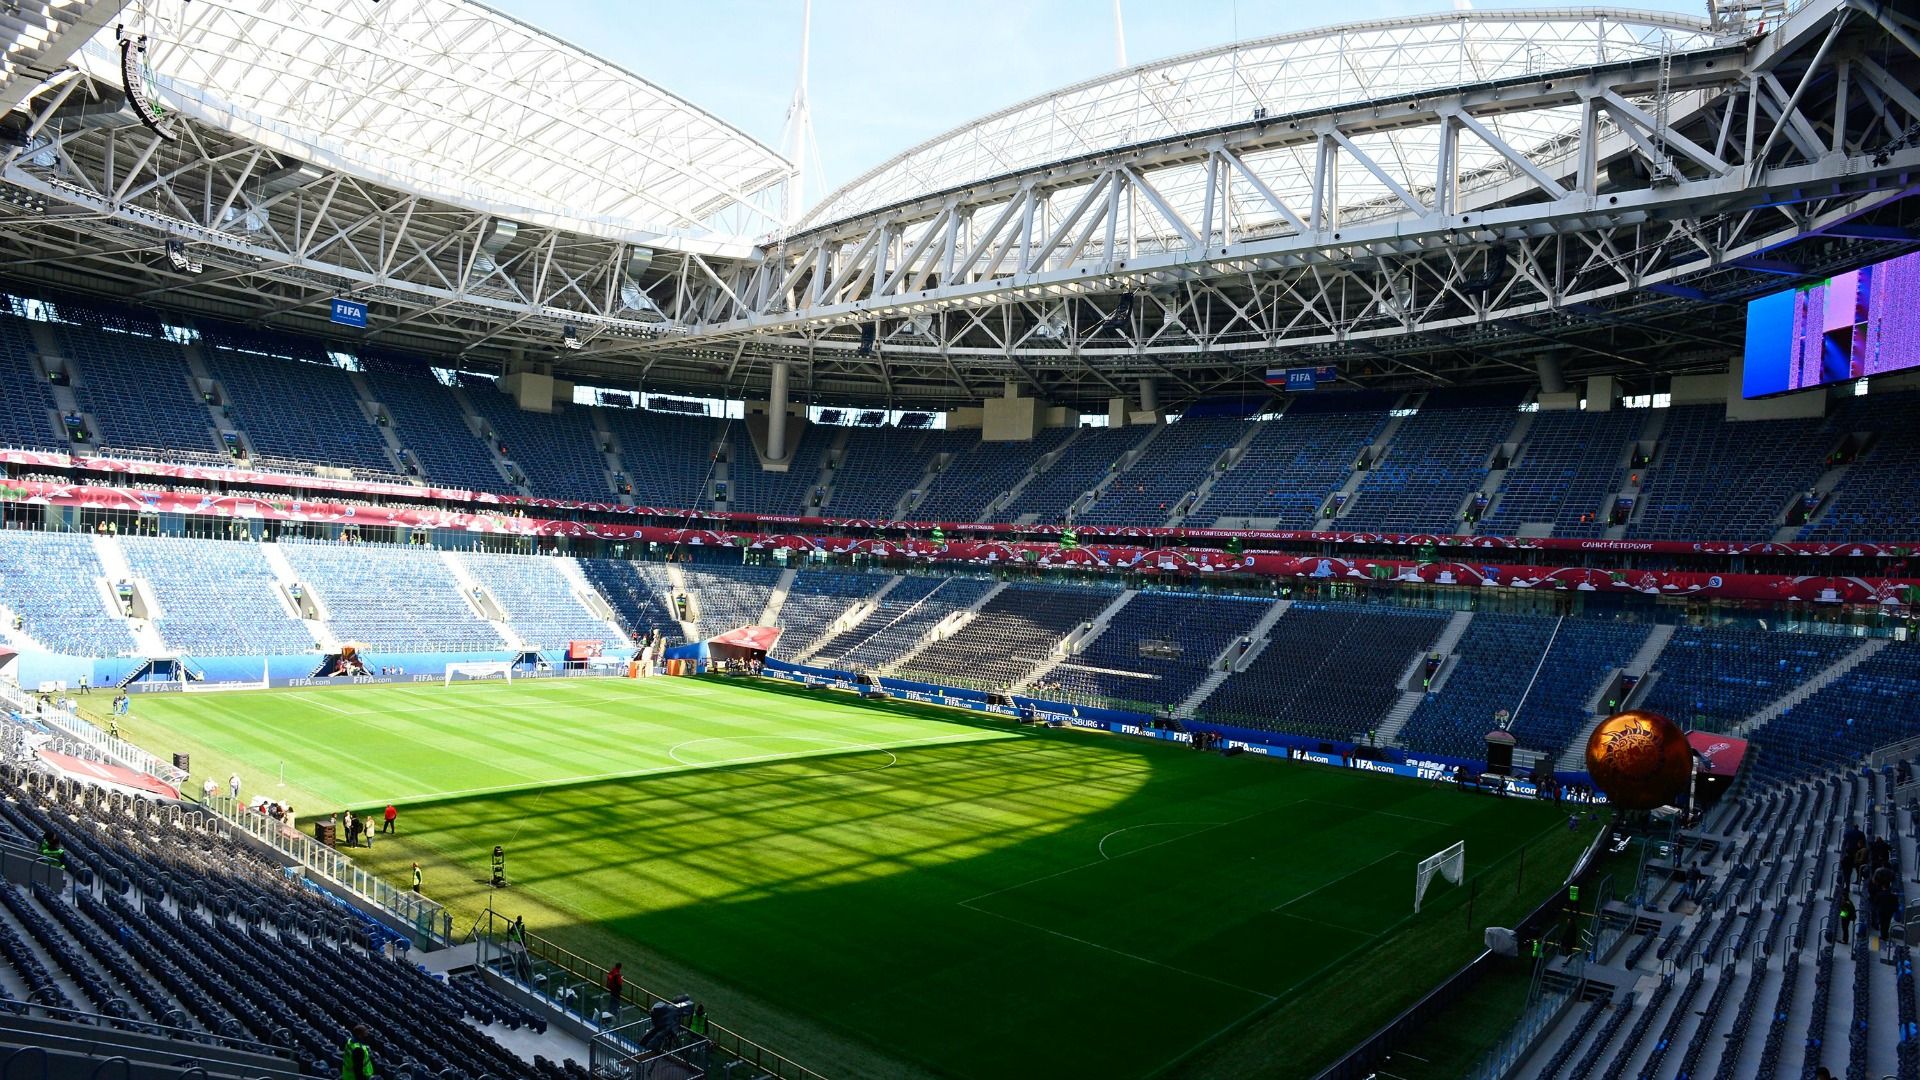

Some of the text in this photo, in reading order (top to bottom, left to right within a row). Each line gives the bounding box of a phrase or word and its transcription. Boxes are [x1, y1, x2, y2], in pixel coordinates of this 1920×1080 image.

[336, 304, 361, 318] FIFA
[1290, 373, 1311, 382] FIFA
[1200, 530, 1248, 538] CONFEDERATIONS
[1581, 540, 1654, 550] САНКТ-ПЕТЕРБУРГ
